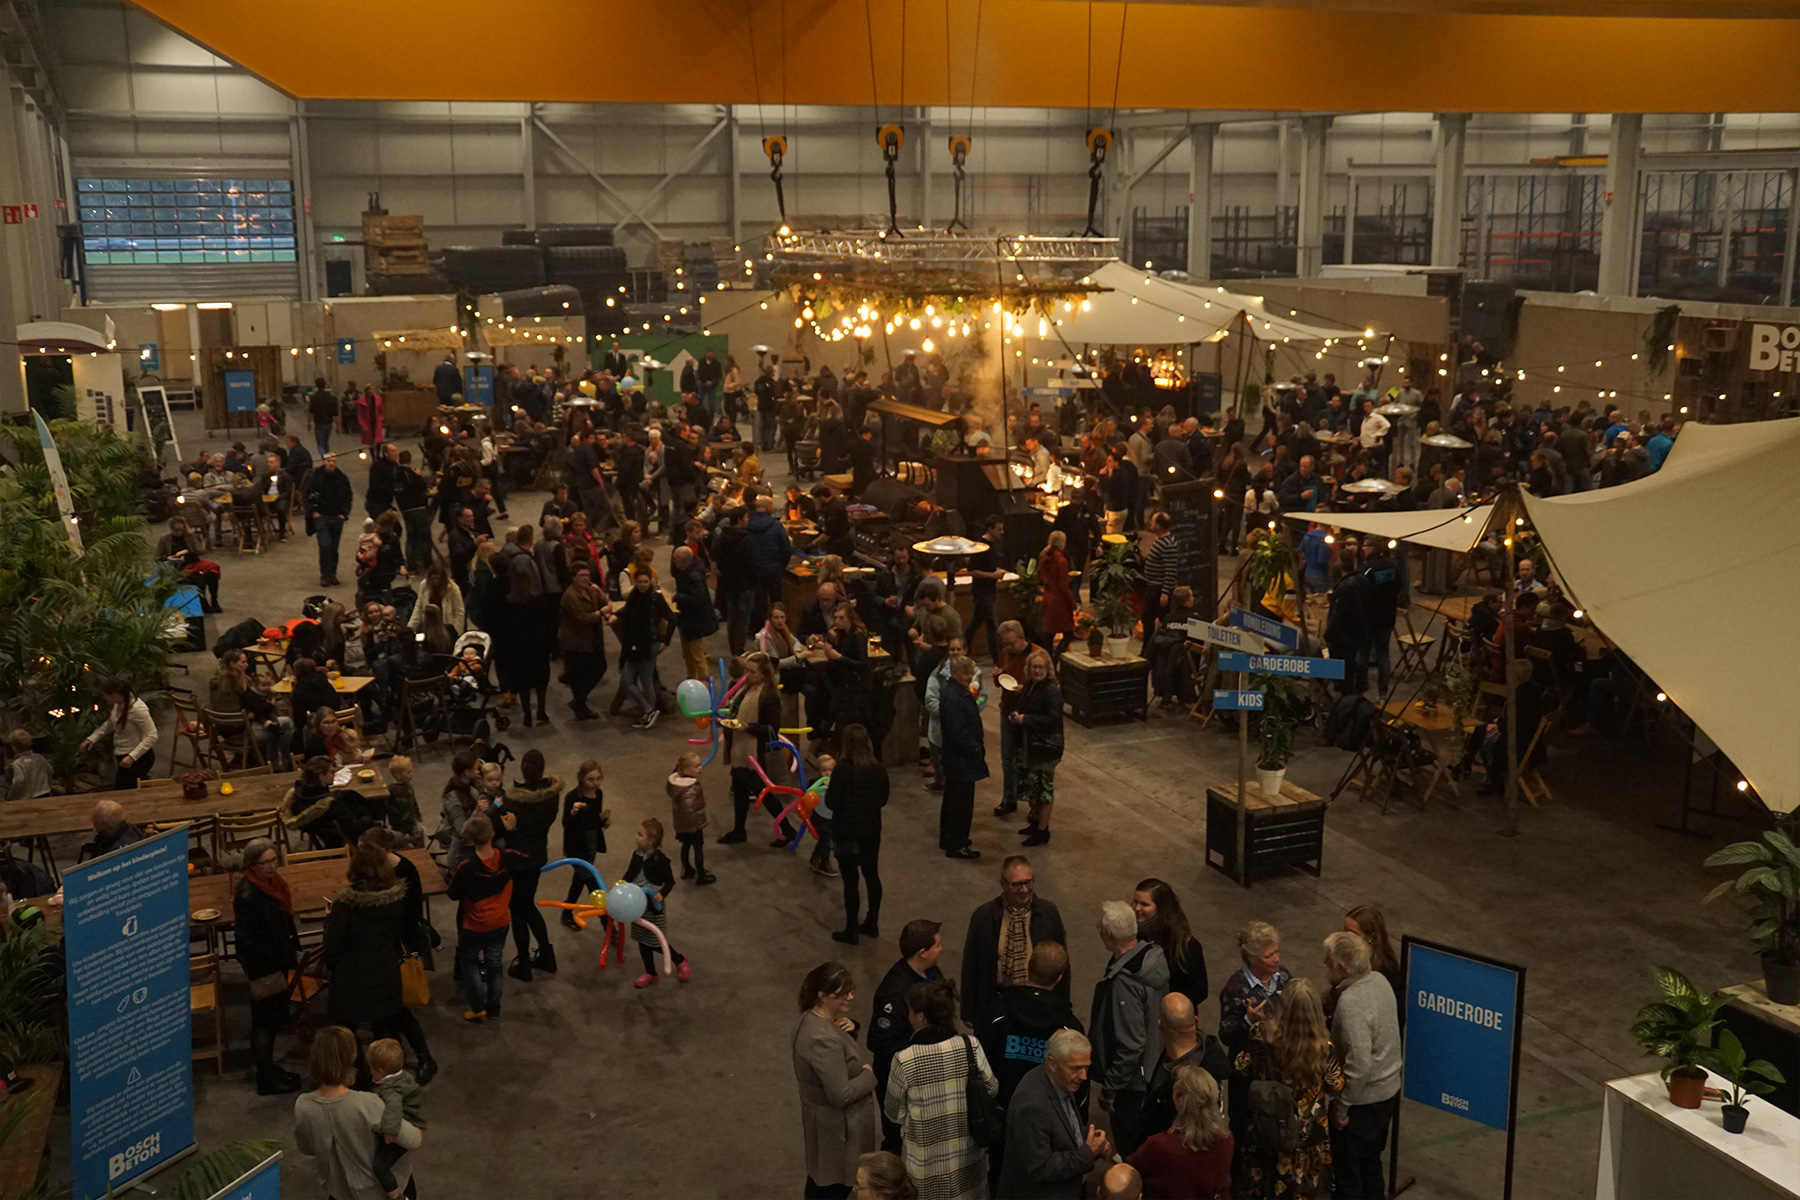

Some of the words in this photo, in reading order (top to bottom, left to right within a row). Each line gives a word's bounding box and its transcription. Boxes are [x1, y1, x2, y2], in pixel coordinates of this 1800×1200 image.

[1207, 626, 1241, 646] TOILETTEN
[1249, 656, 1311, 674] GARDEROBE
[1238, 693, 1263, 707] KIDS
[1417, 990, 1503, 1031] GARDEROBE
